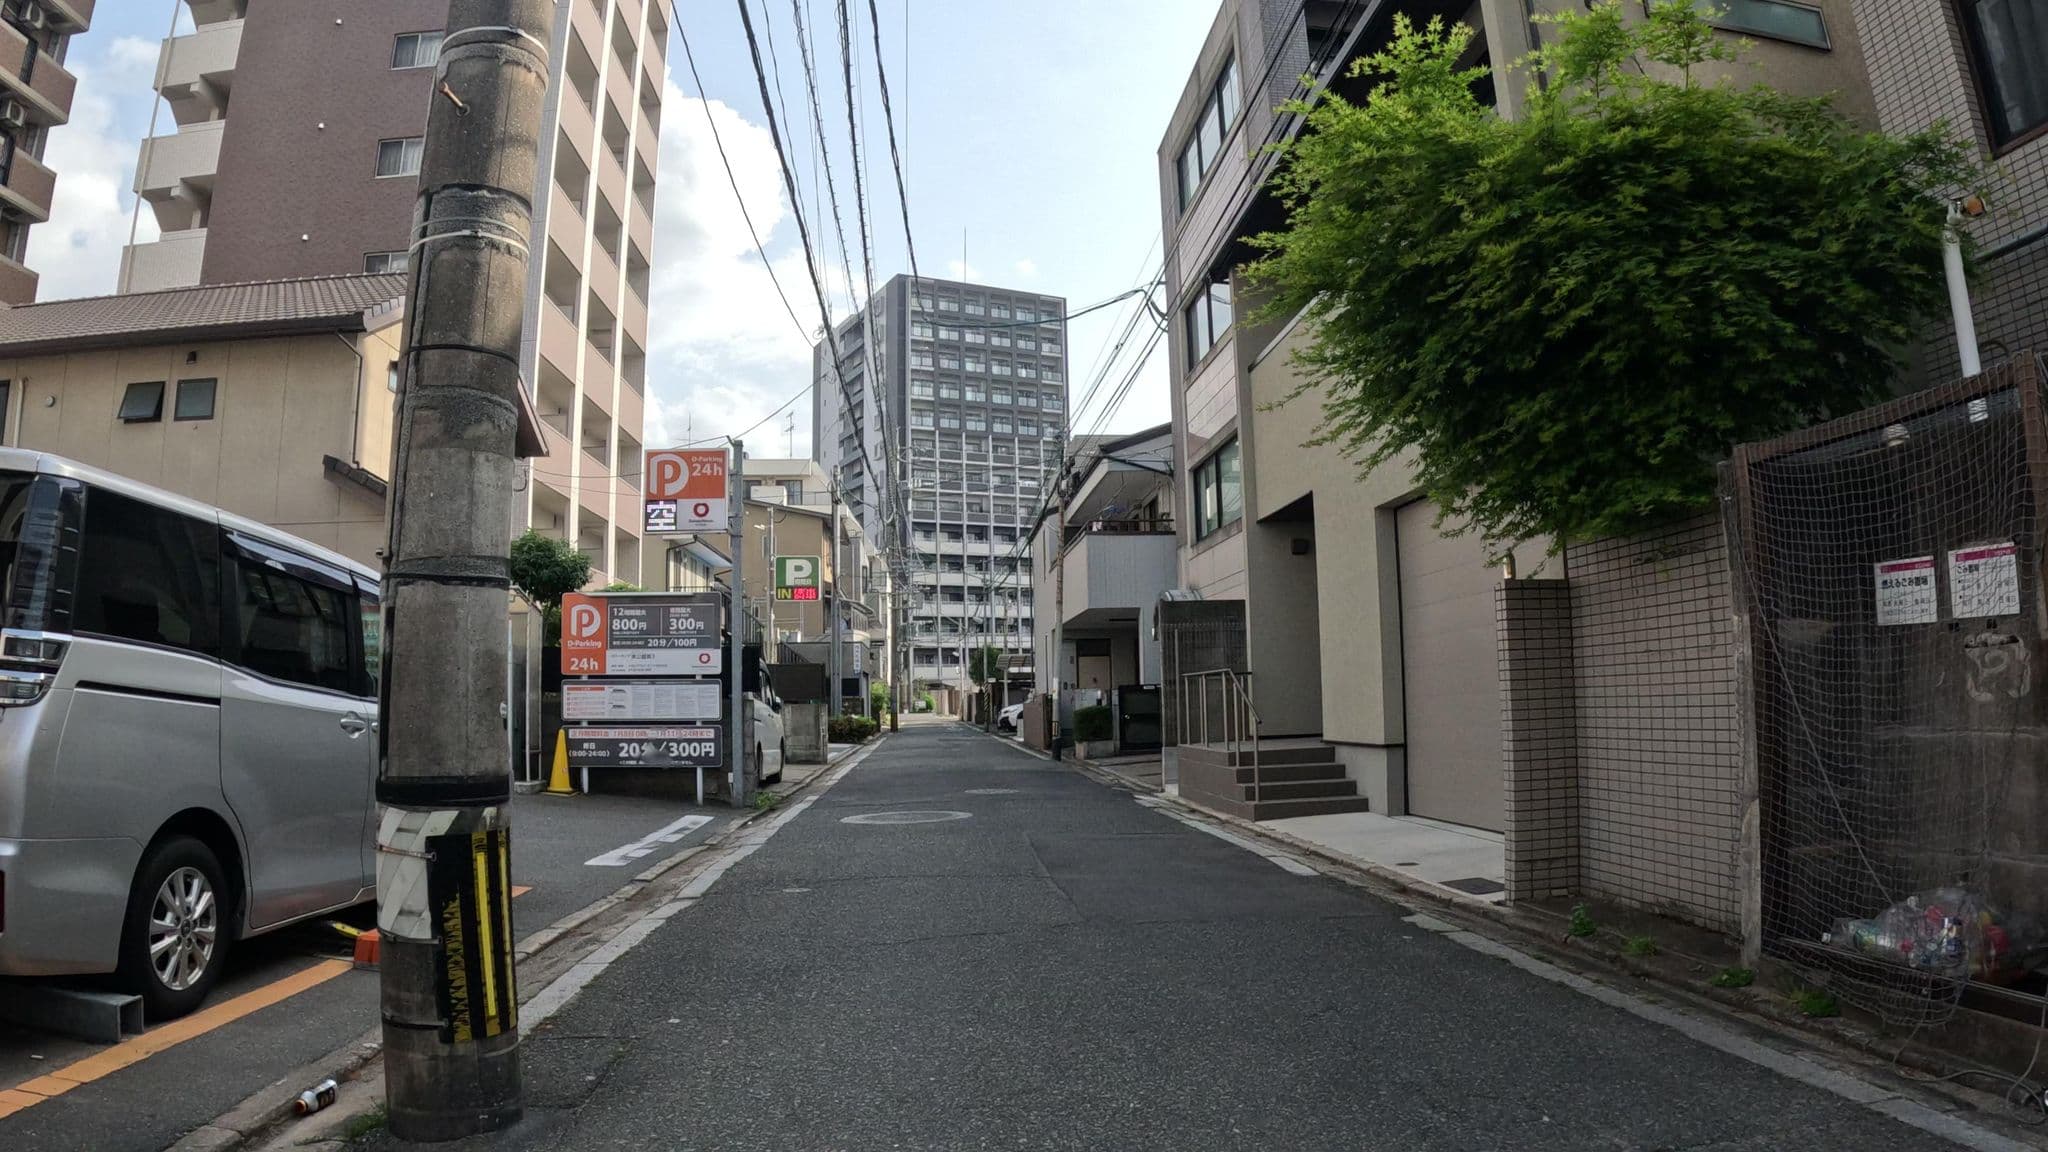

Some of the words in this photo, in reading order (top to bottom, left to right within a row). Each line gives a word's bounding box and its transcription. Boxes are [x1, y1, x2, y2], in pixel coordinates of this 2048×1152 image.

[692, 463, 722, 476] 24h
[646, 501, 677, 531] 空
[786, 559, 812, 585] P
[777, 588, 791, 599] IN
[612, 618, 647, 631] 800円
[669, 618, 704, 631] 300円
[567, 640, 602, 649] D-Parking
[570, 657, 599, 671] 24h
